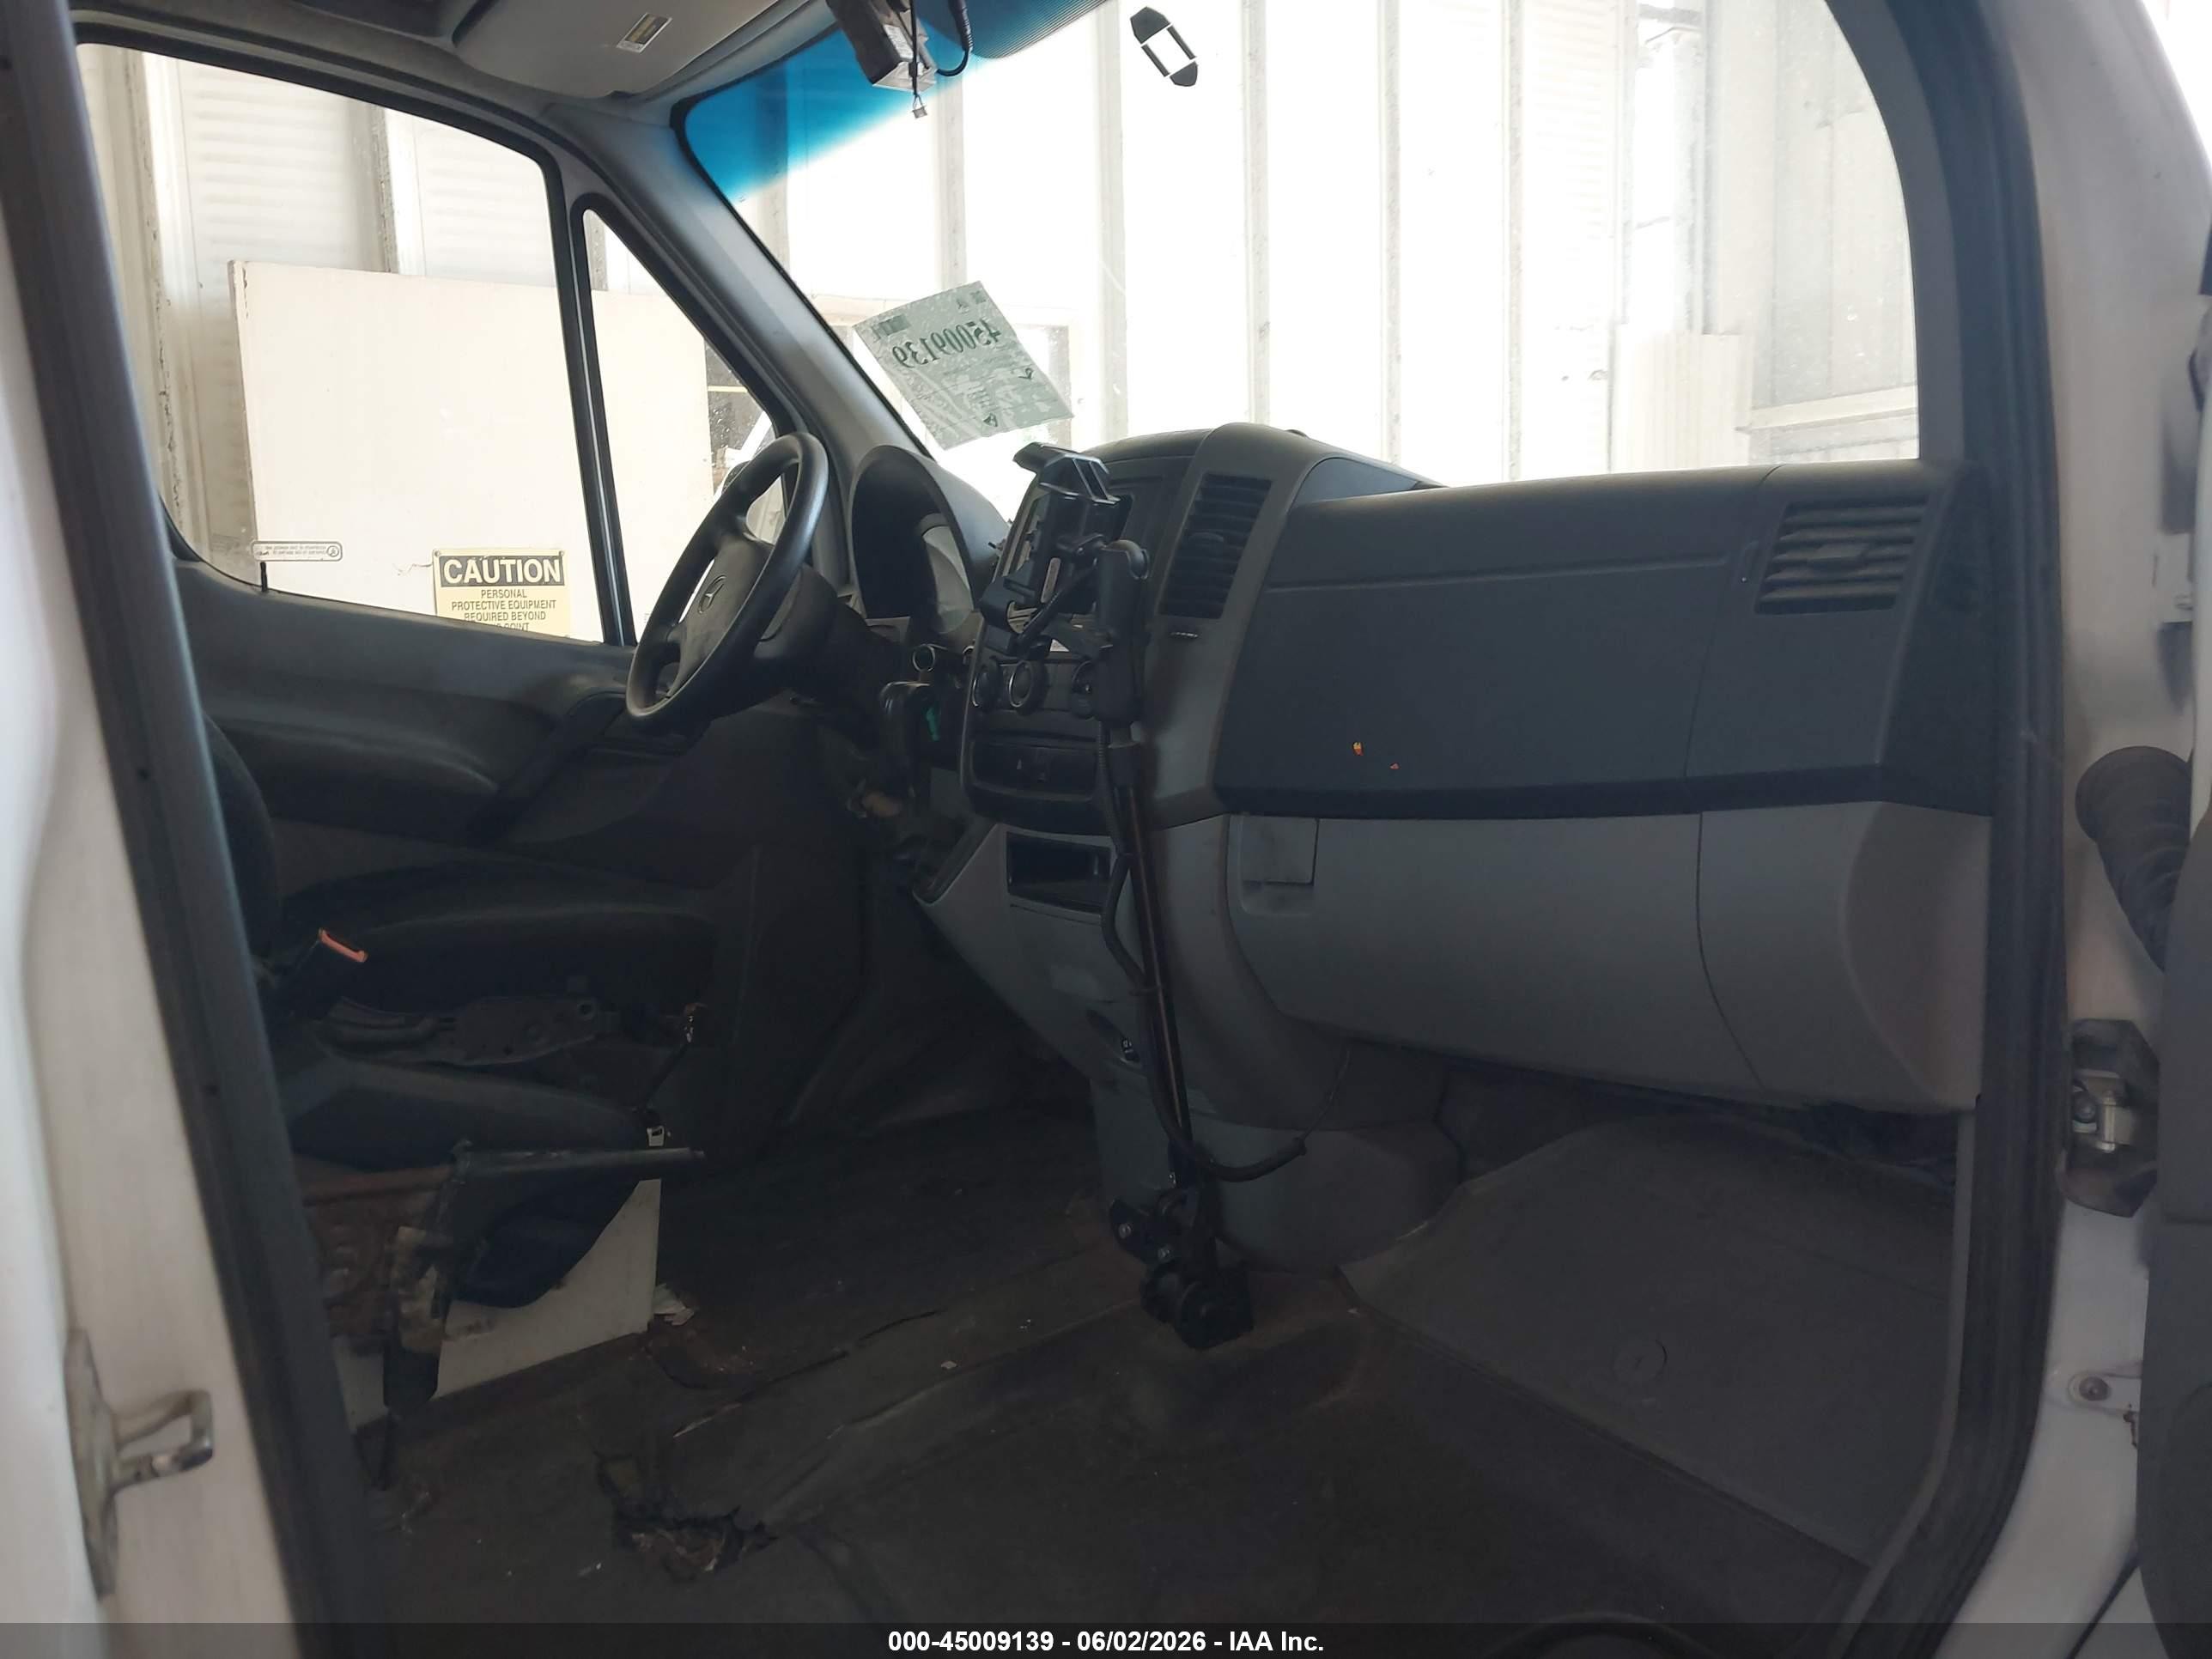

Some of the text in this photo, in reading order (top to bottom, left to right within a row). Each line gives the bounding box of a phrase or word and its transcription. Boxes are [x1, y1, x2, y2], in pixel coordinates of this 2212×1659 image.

[443, 558, 562, 584] CAUTION
[481, 588, 527, 599] PERSONAL
[452, 599, 556, 611] PROTECTIVE EQUIPMENT
[464, 611, 546, 622] REQUIRED BEYOND
